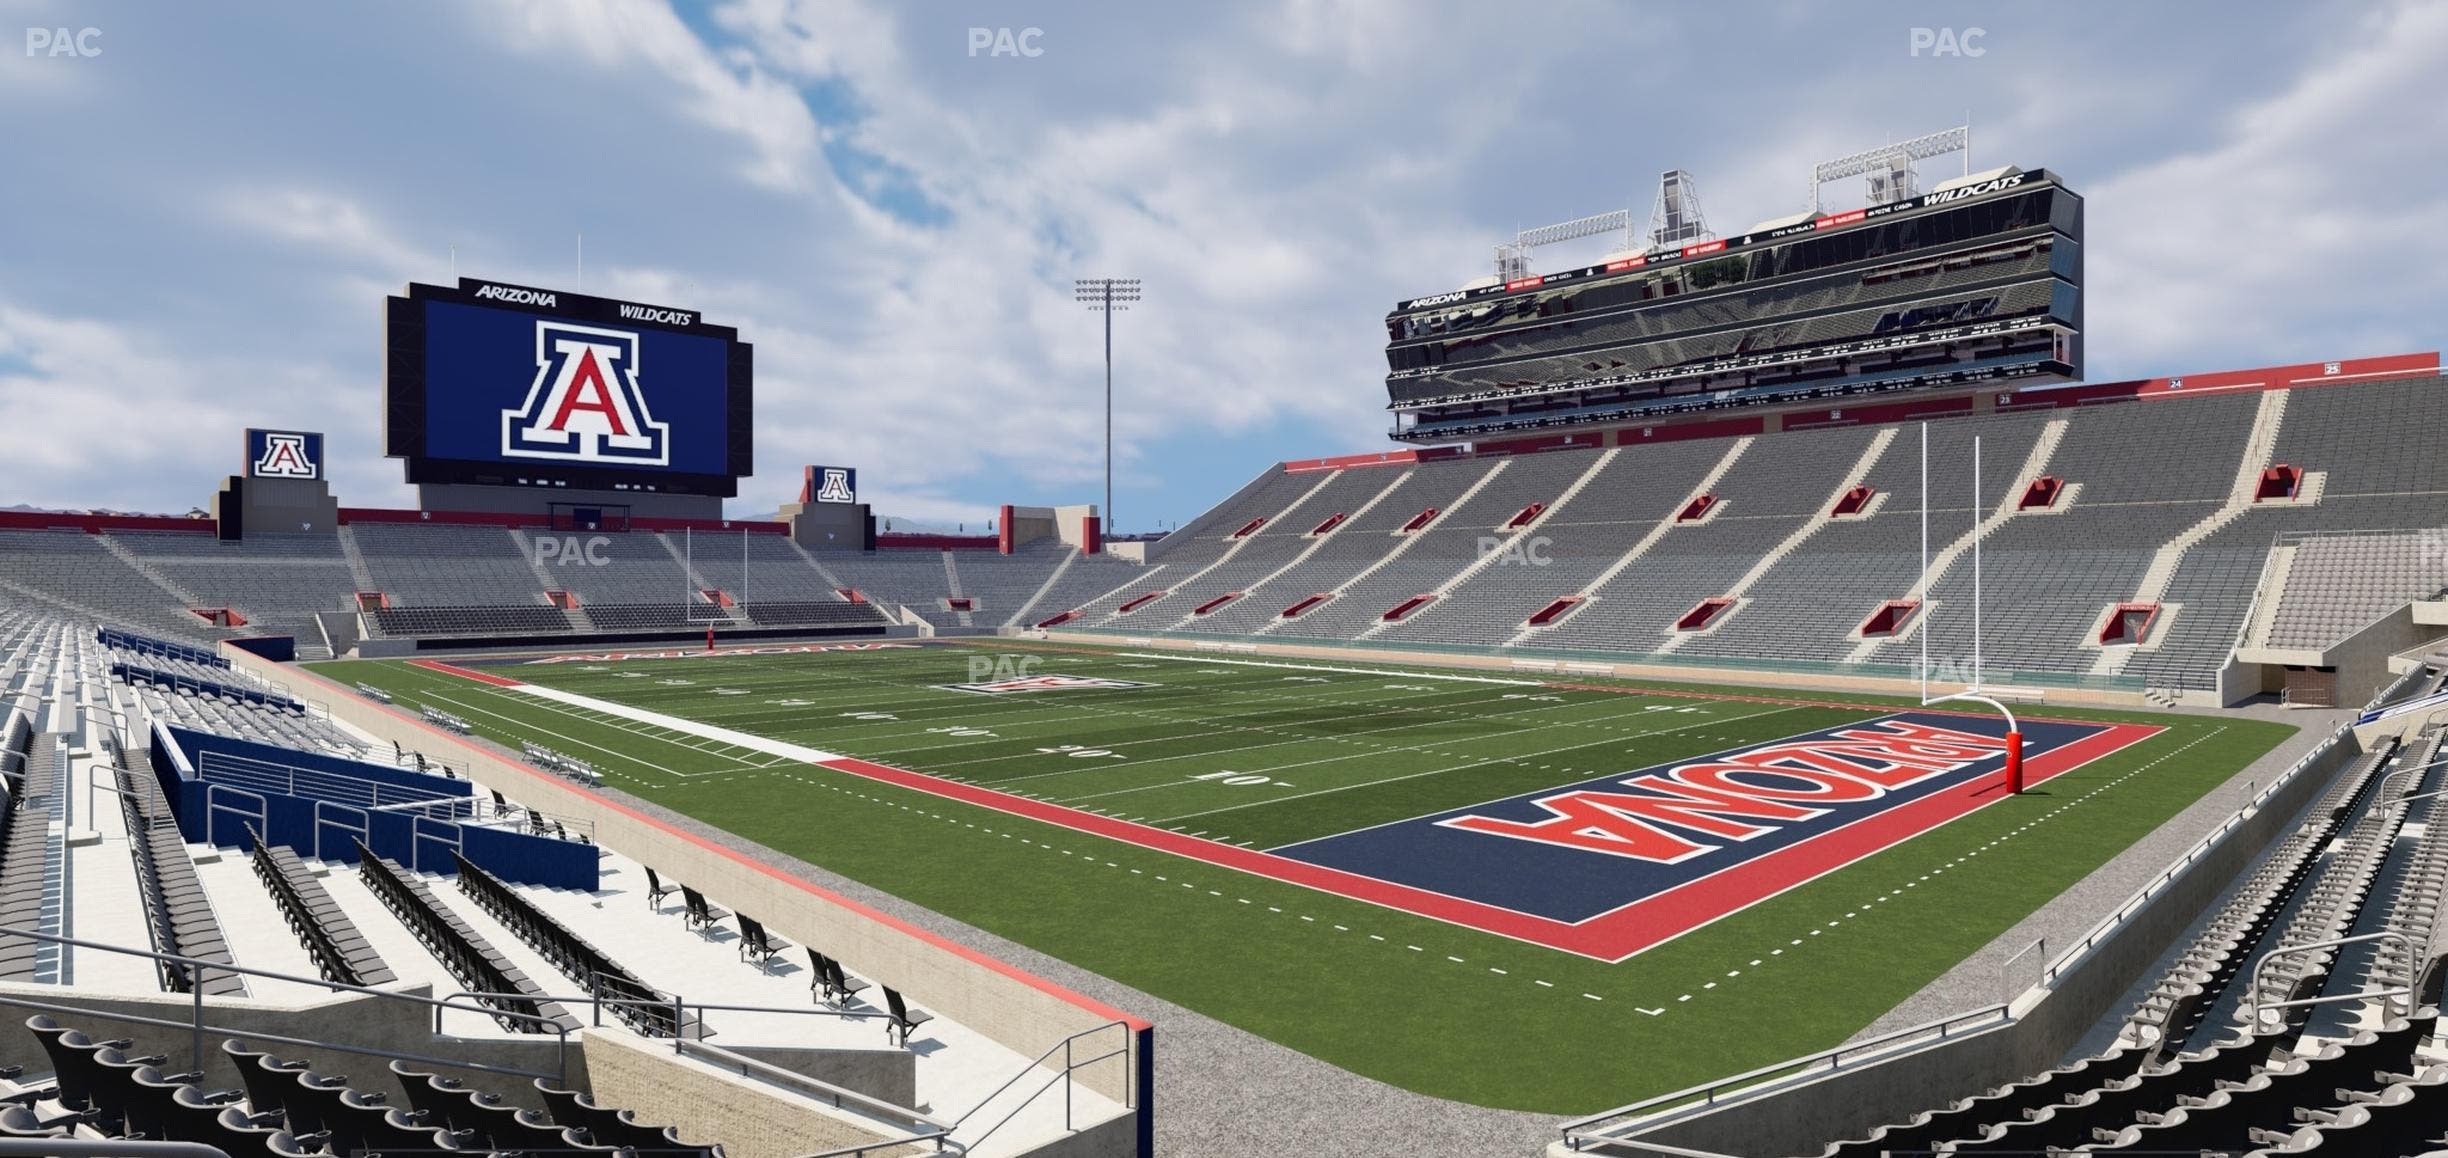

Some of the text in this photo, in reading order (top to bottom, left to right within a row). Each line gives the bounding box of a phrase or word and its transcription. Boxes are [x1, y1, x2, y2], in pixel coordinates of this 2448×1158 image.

[1923, 173, 2025, 207] WILDCATS
[475, 284, 692, 327] ARIZONA WILDCATS
[1407, 291, 1467, 309] ARIZONA
[501, 319, 670, 467] A
[254, 433, 317, 479] A
[817, 469, 854, 503] A
[1034, 744, 1113, 758] 20
[1185, 769, 1272, 786] 10
[1432, 720, 2033, 866] ARIZONA
